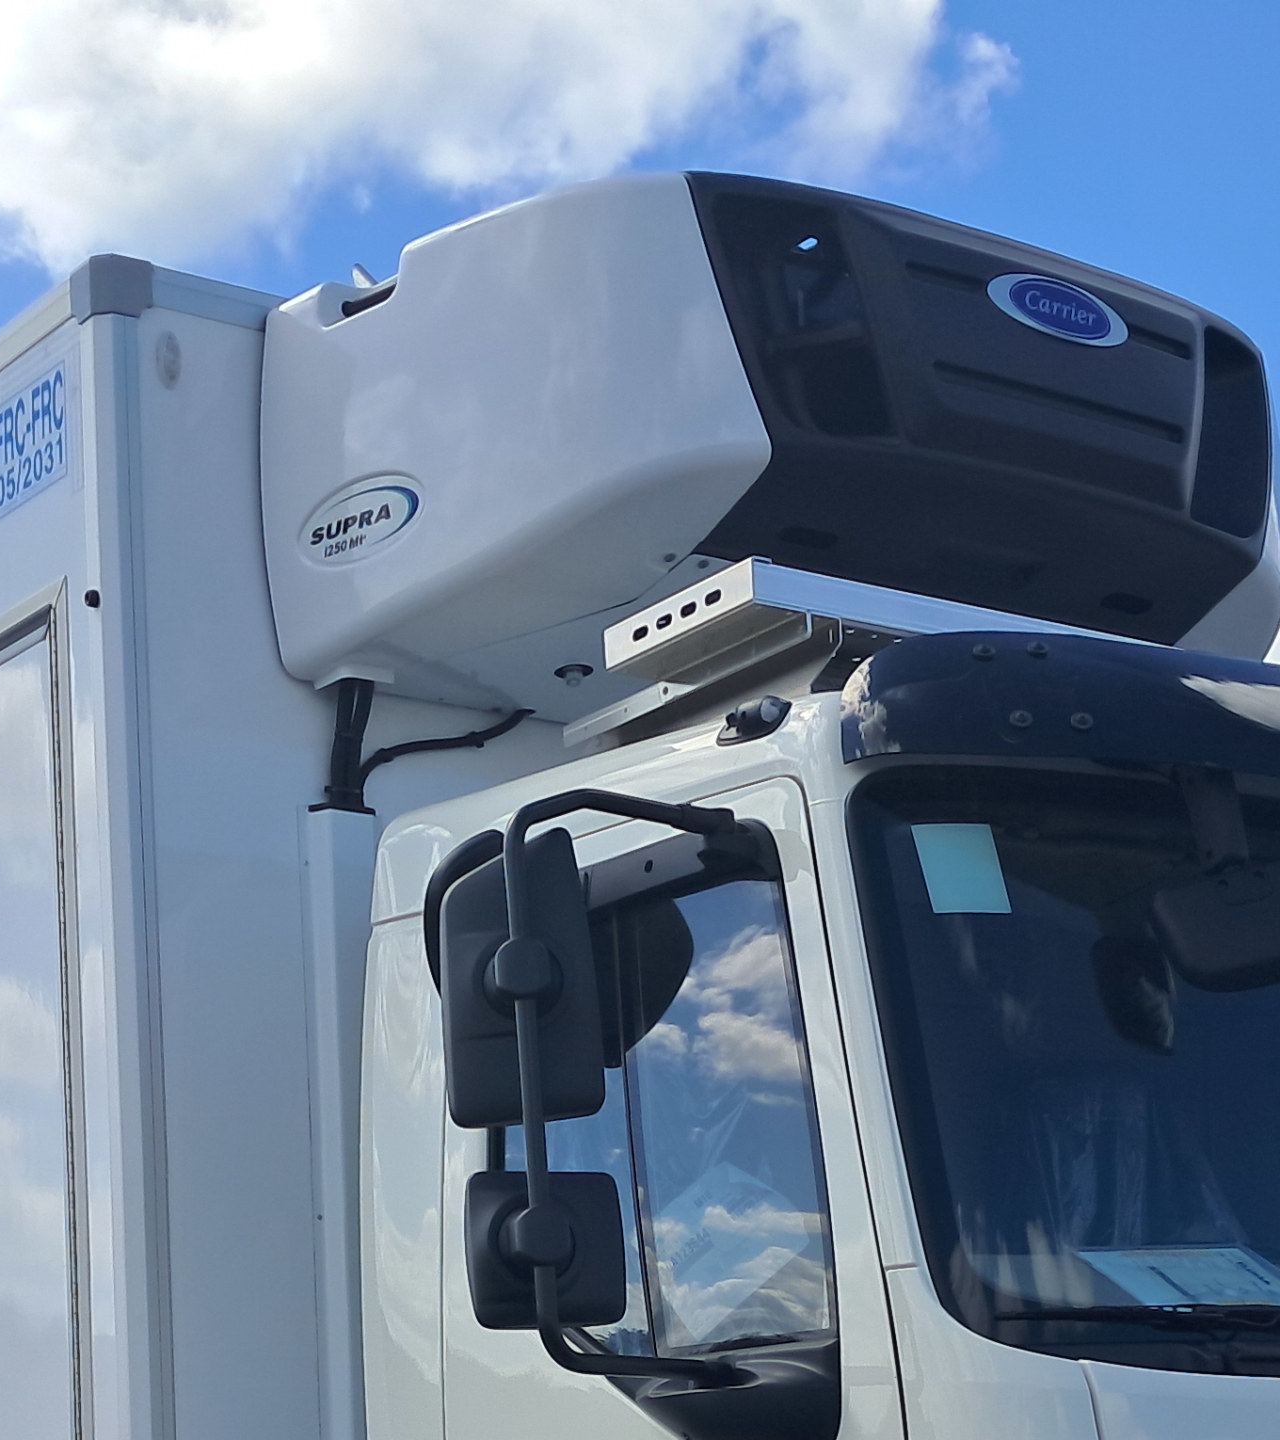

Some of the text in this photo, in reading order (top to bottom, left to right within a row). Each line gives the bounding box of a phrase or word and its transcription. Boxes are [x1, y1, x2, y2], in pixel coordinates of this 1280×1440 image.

[1024, 289, 1097, 327] Carrier
[310, 503, 391, 546] SUPRA
[324, 540, 347, 558] 1250
